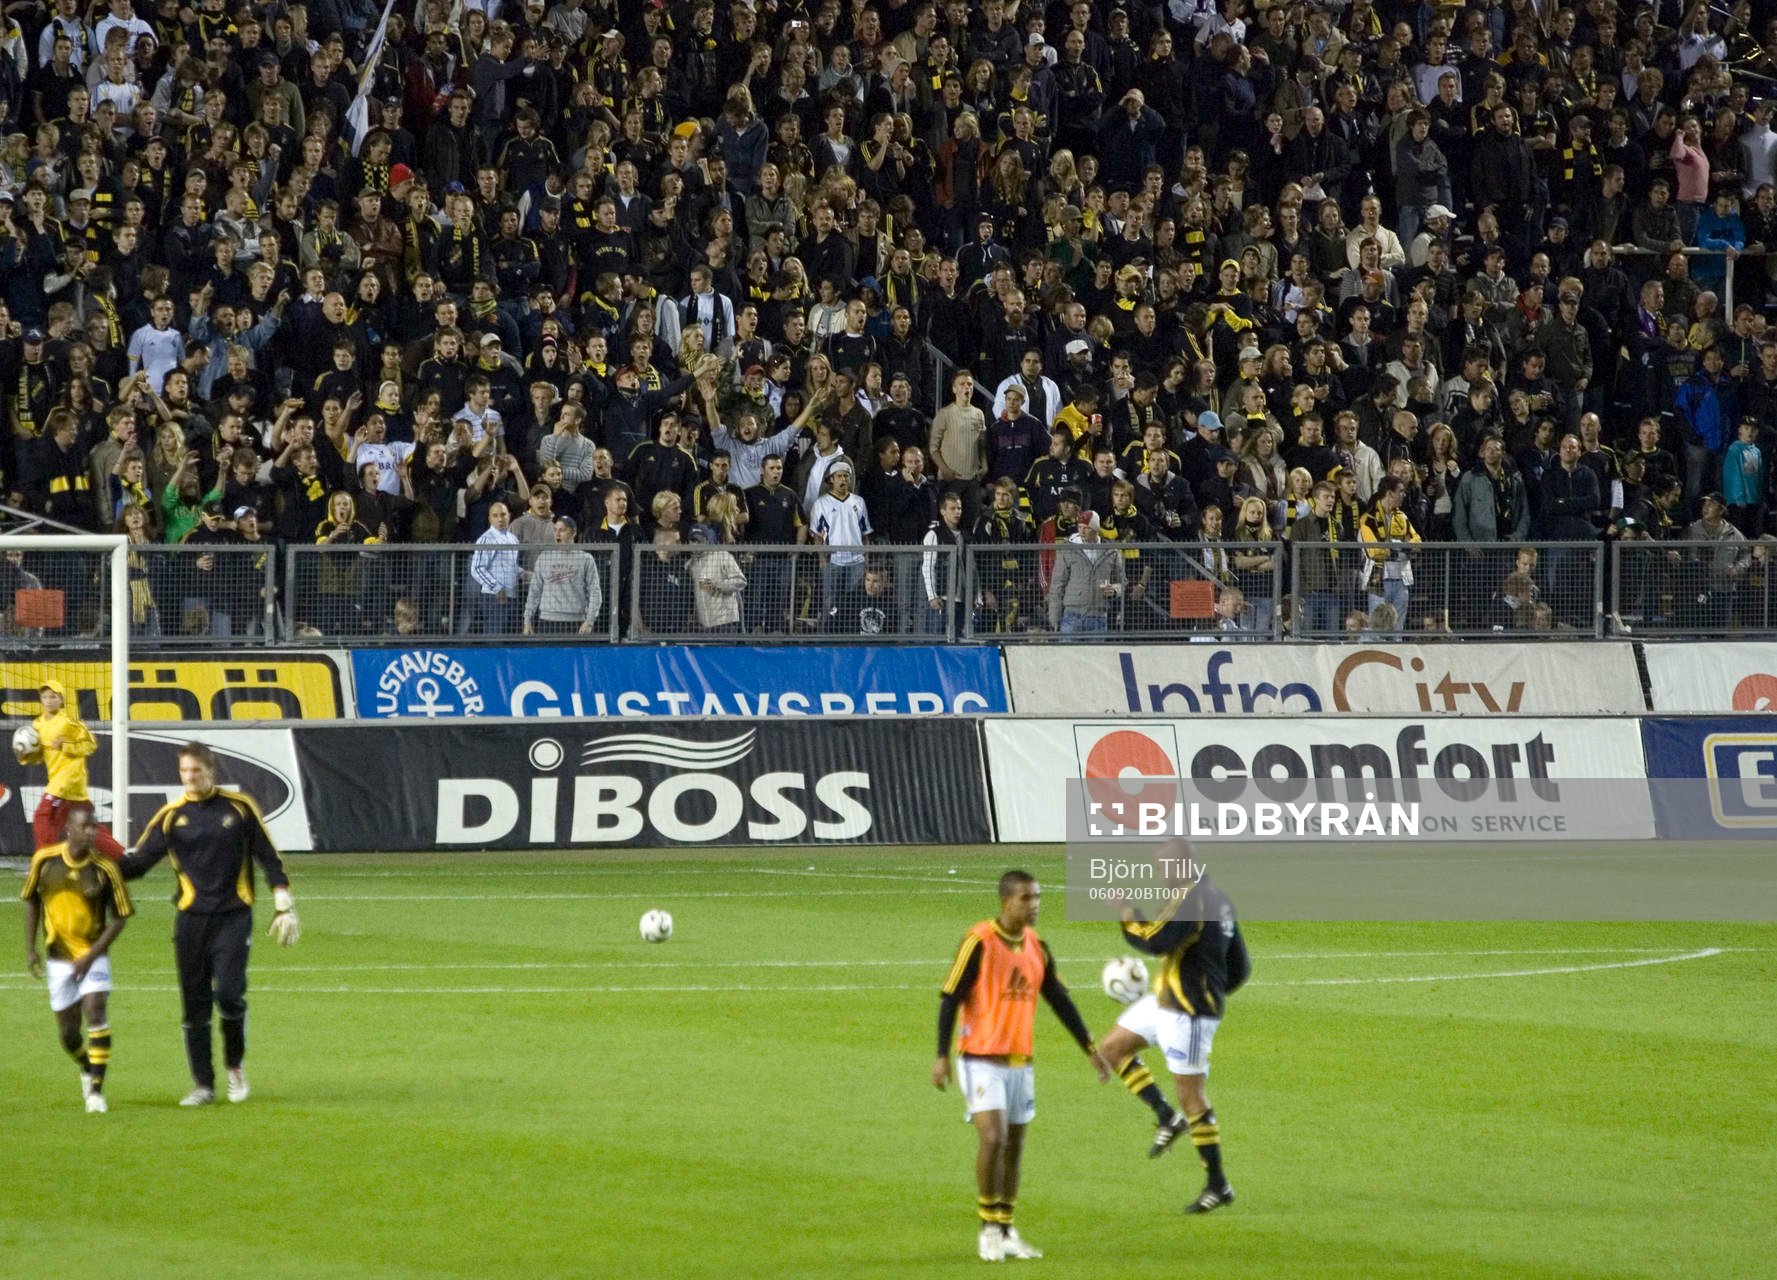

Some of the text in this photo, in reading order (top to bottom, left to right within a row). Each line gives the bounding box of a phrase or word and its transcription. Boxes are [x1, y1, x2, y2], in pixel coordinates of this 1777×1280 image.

[376, 651, 485, 718] USTAVSBER
[1191, 725, 1559, 803] comfort
[1472, 815, 1567, 832] SERVICE
